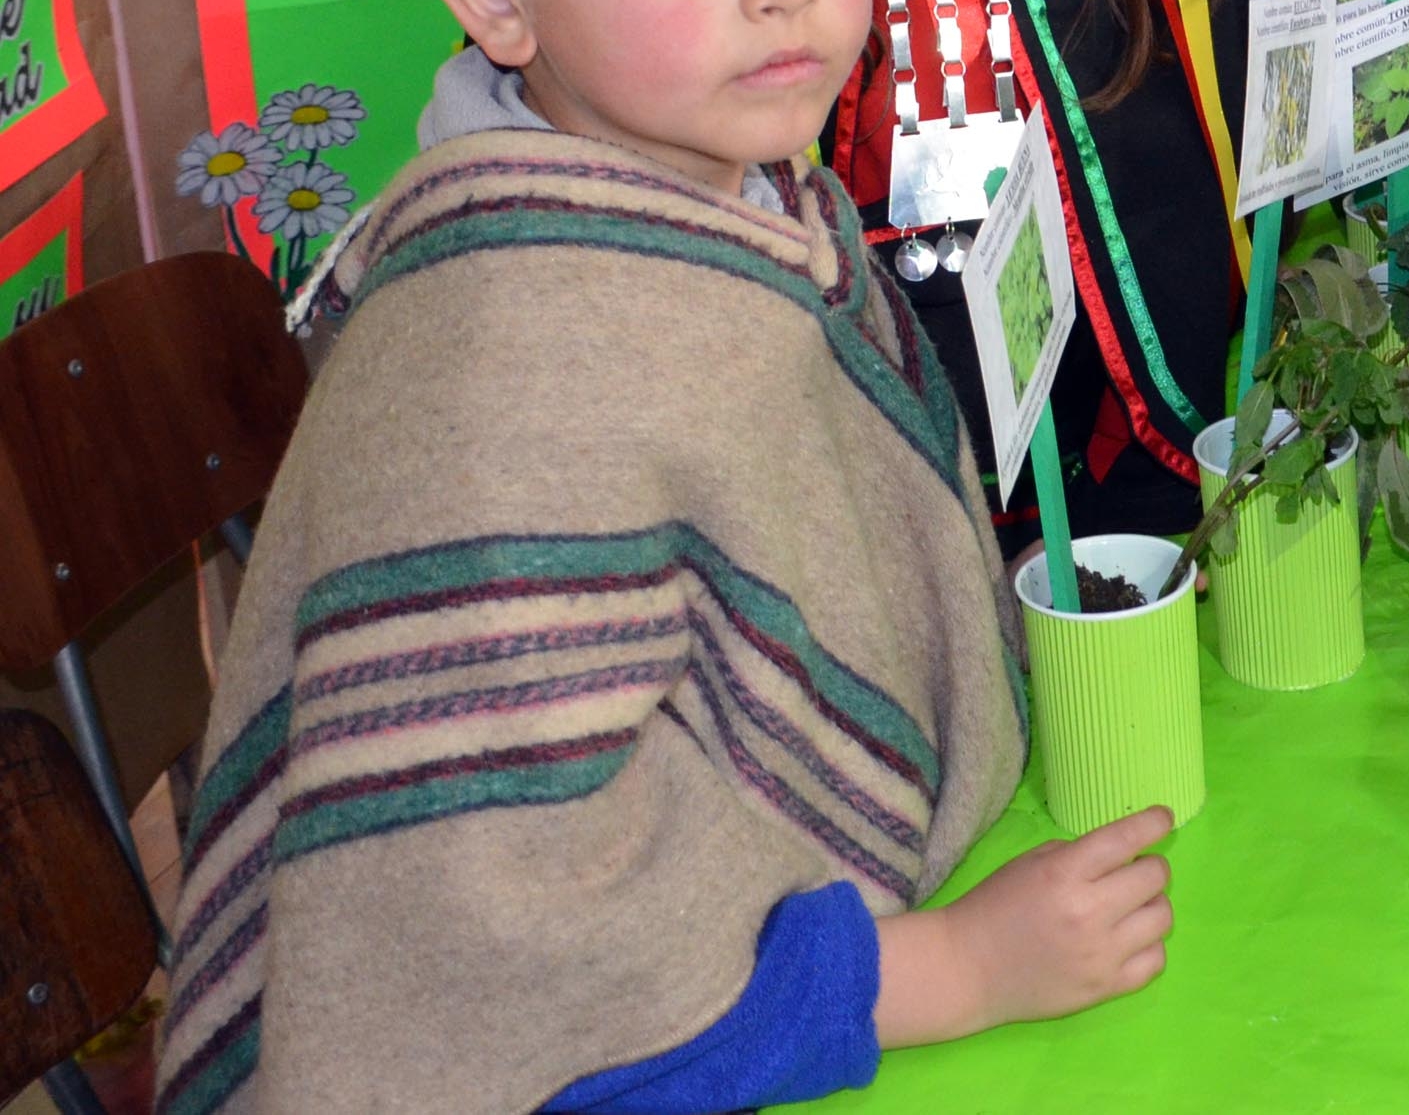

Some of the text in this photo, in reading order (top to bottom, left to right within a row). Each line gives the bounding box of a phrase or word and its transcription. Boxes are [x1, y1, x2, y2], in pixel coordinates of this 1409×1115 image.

[1335, 31, 1355, 46] mbre
[1335, 45, 1355, 59] mbre
[1325, 169, 1344, 184] para
[1346, 162, 1355, 174] el
[1382, 142, 1409, 159] limpia
[1364, 164, 1387, 180] sirve
